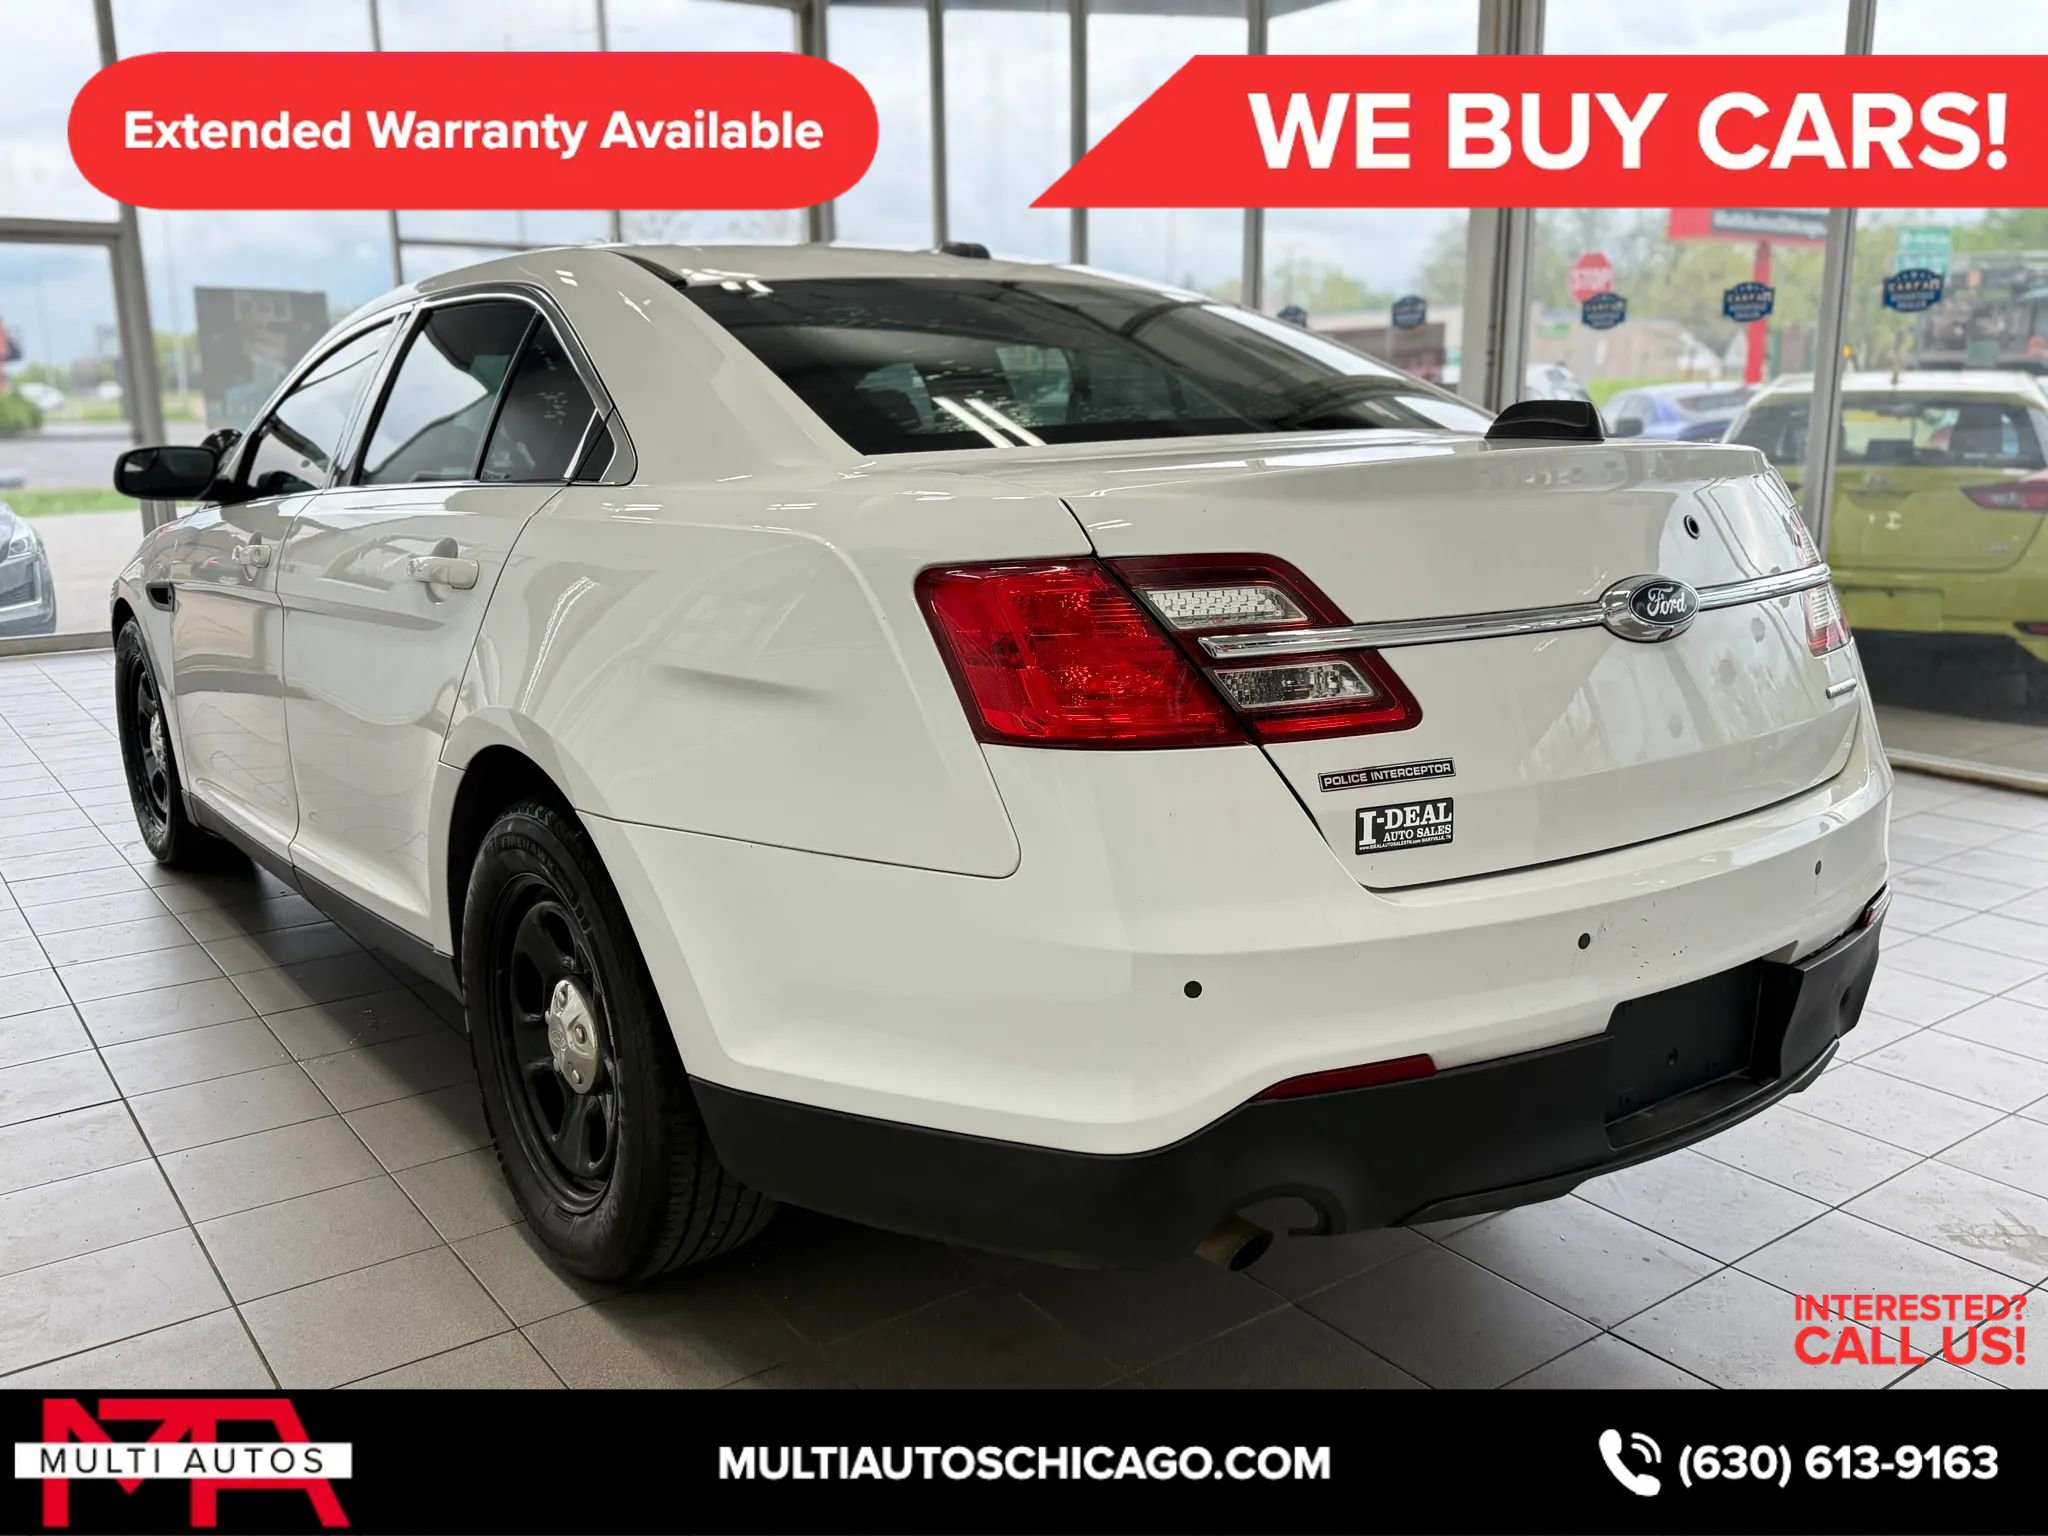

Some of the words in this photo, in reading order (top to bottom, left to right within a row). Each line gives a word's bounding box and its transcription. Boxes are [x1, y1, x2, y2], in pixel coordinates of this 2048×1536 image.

[1646, 586, 1687, 617] Ford
[1324, 772, 1368, 787] POLICE
[1371, 762, 1452, 781] INTERCEPTOR
[1359, 802, 1452, 846] I-DEAL
[1383, 829, 1414, 842] AUTO
[1417, 824, 1452, 838] SALES
